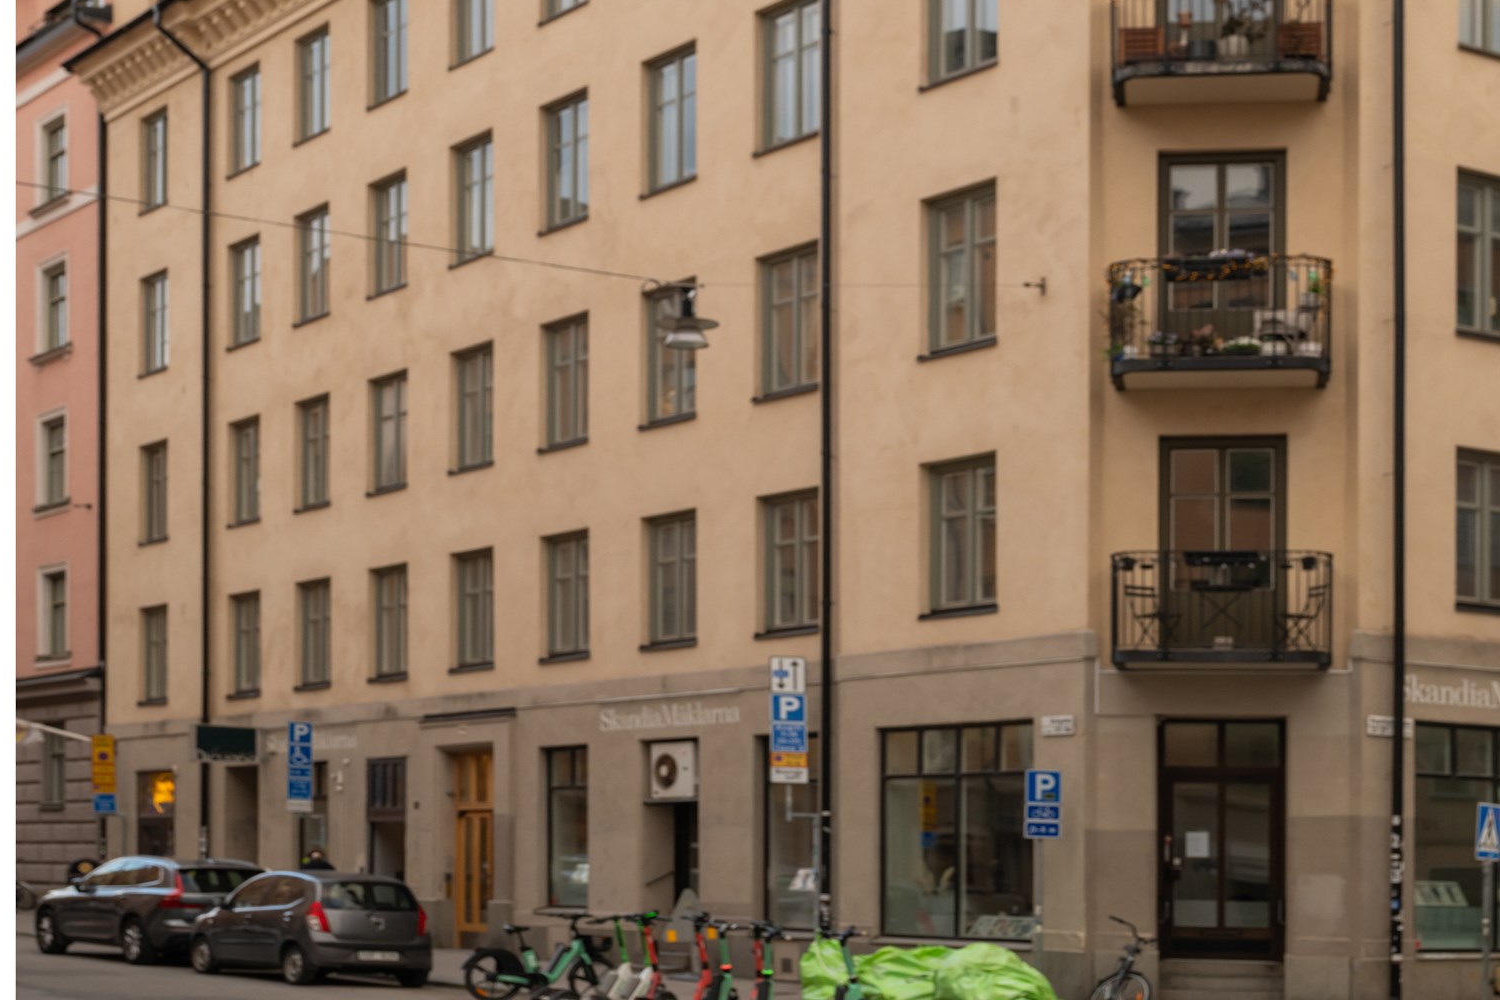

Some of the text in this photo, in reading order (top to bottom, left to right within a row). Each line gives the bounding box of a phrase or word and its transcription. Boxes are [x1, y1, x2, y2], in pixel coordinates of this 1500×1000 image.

[779, 696, 801, 720] P
[294, 723, 309, 741] P
[1034, 773, 1056, 801] P
